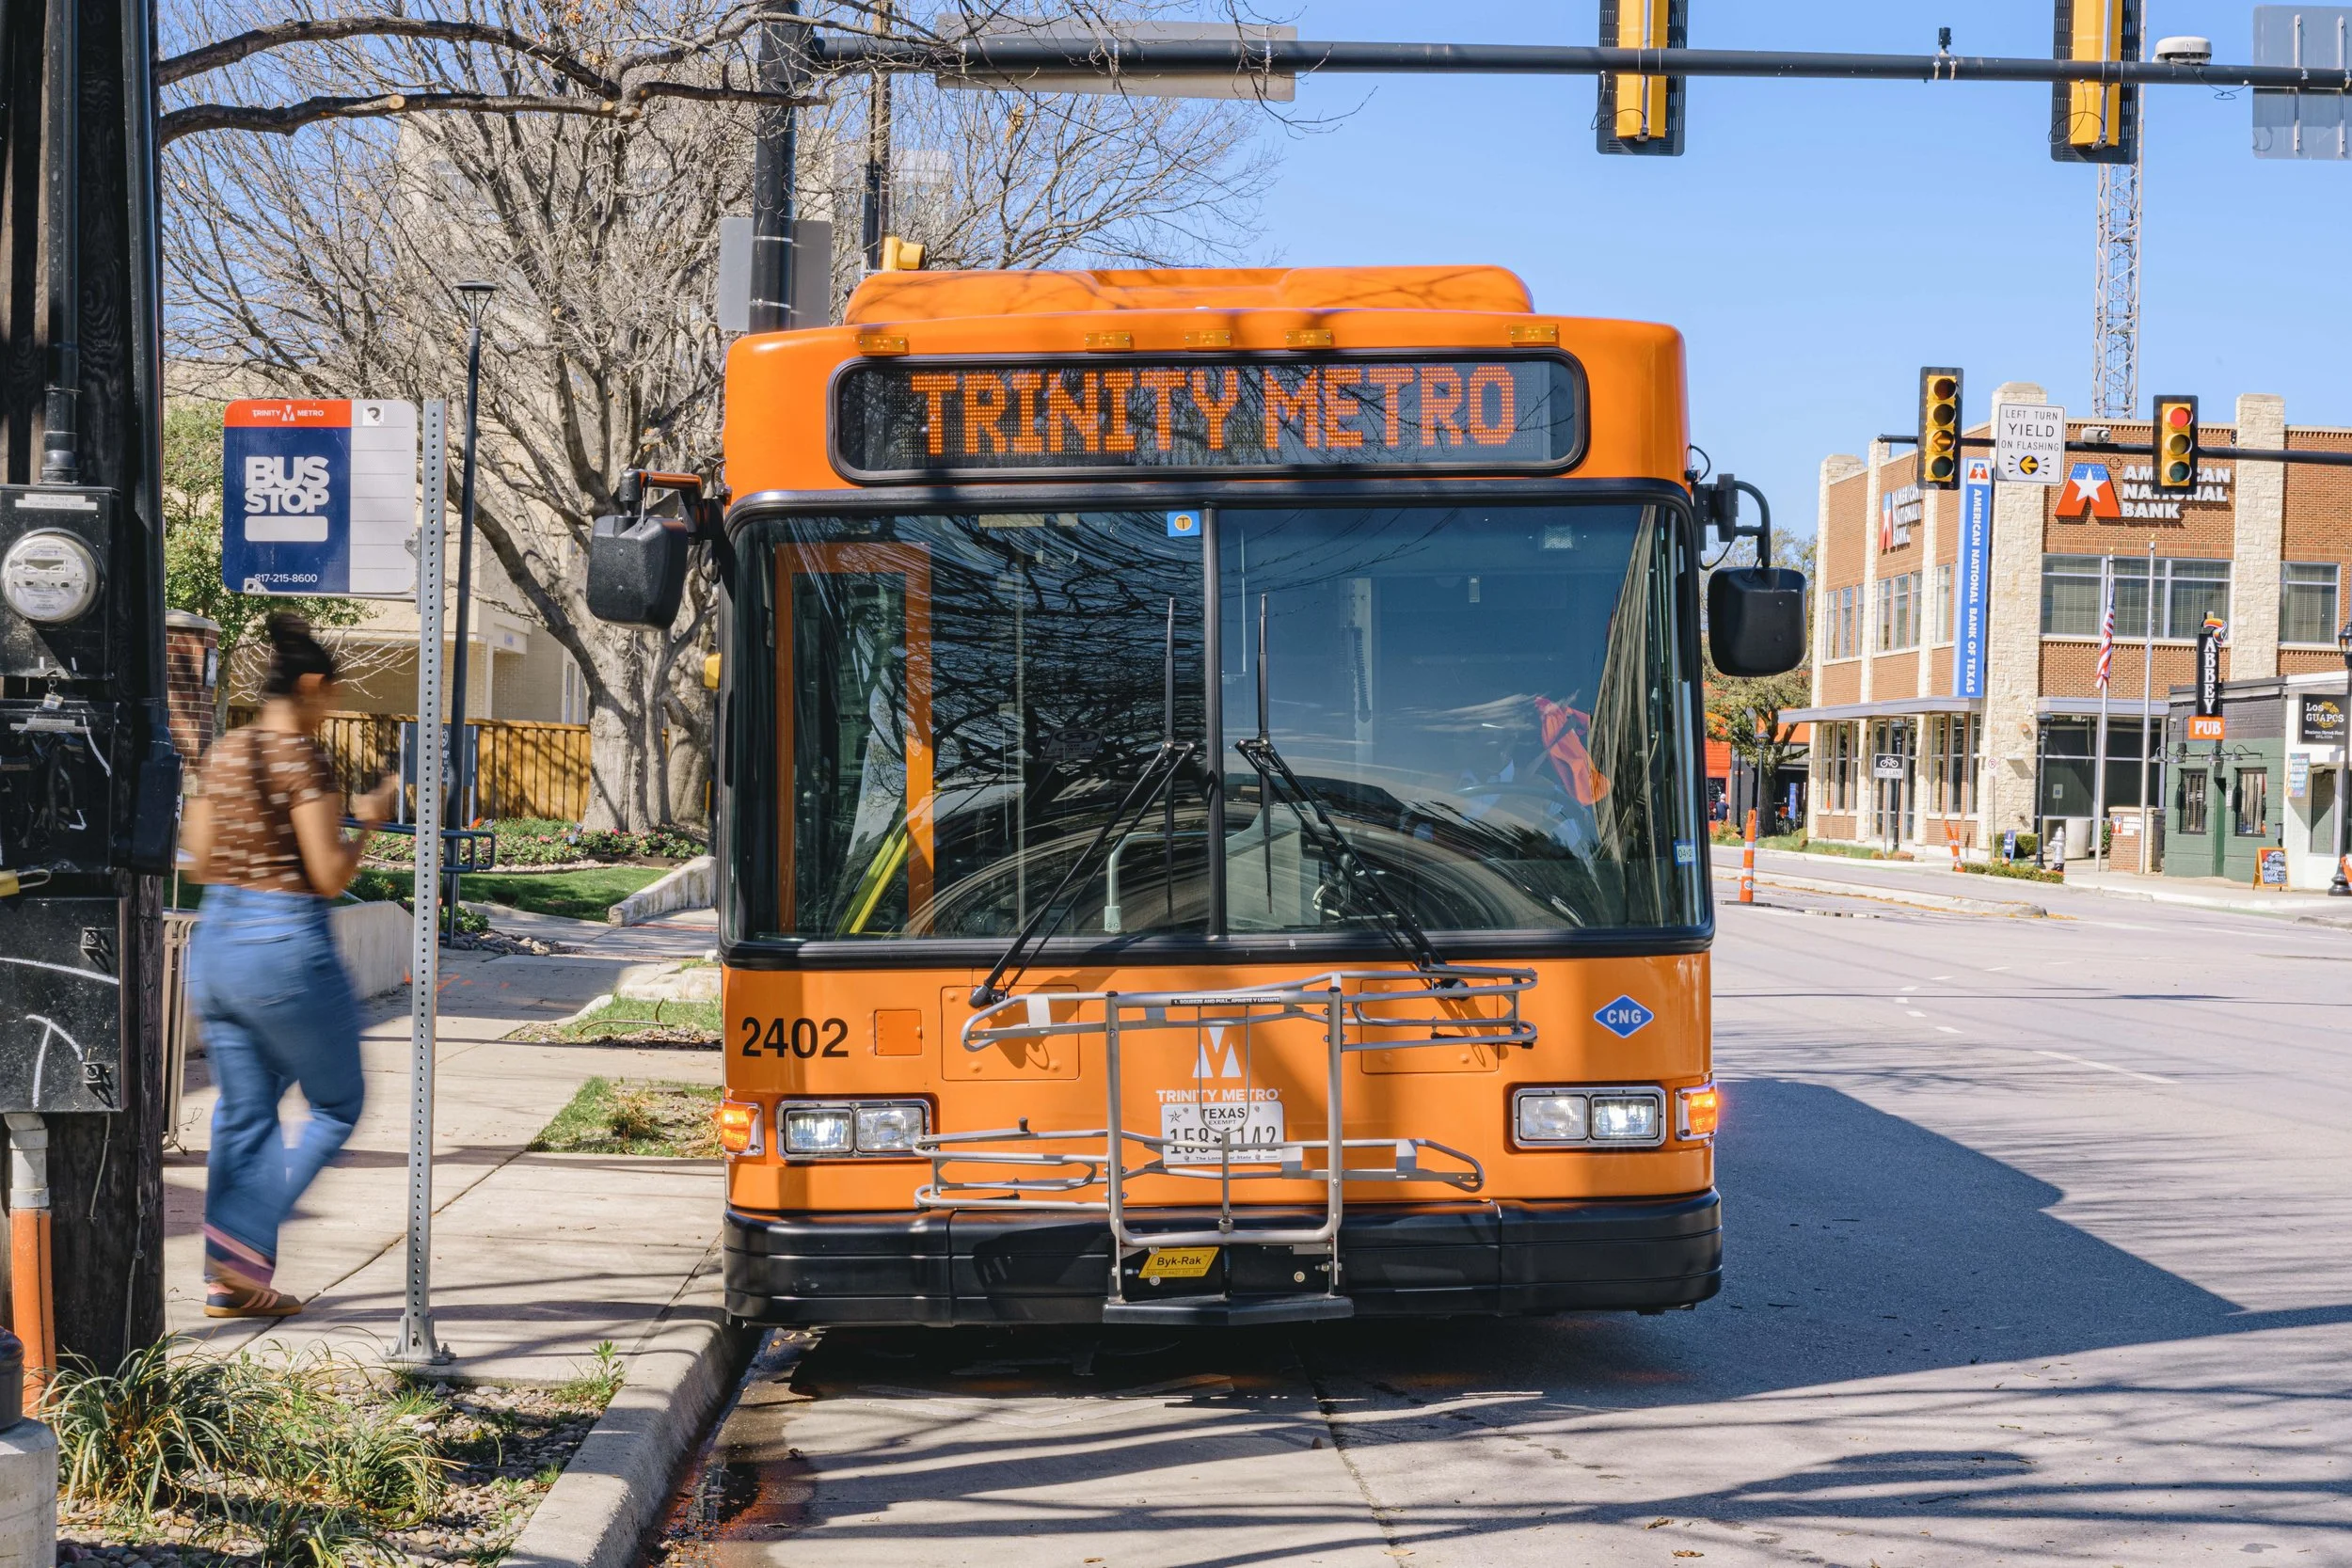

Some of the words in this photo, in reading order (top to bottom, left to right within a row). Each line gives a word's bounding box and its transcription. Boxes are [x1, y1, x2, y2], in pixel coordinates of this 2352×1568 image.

[252, 409, 281, 418] TRINITY
[911, 369, 1238, 455] TRINITY
[1263, 366, 1514, 450] METRO
[2005, 409, 2026, 419] LEFT
[2035, 410, 2058, 420] TURN
[2009, 423, 2055, 437] YIELD
[2001, 439, 2013, 449] ON
[2017, 440, 2059, 451] FLASHING
[245, 455, 330, 489] BUS
[2122, 465, 2231, 483] AMAN
[2122, 483, 2228, 501] NAAL
[244, 487, 330, 514] STOP
[1972, 488, 1982, 546] AMERICAN
[2122, 502, 2181, 518] BANK
[1178, 517, 1189, 530] T
[254, 574, 318, 583] 817-215-8600
[1969, 549, 1980, 605] NATIONAL
[1967, 608, 1978, 639] BANK
[1967, 641, 1976, 656] OF
[1965, 657, 1976, 693] TEXAS
[2203, 637, 2217, 714] ABBEY
[2194, 720, 2222, 736] PUB
[1607, 1009, 1642, 1024] CNG
[741, 1017, 849, 1058] 2402
[1156, 1089, 1218, 1102] TRINITY
[1223, 1088, 1279, 1101] METRO
[1201, 1107, 1246, 1119] TEXAS
[1157, 1256, 1201, 1268] Byk-Rak
